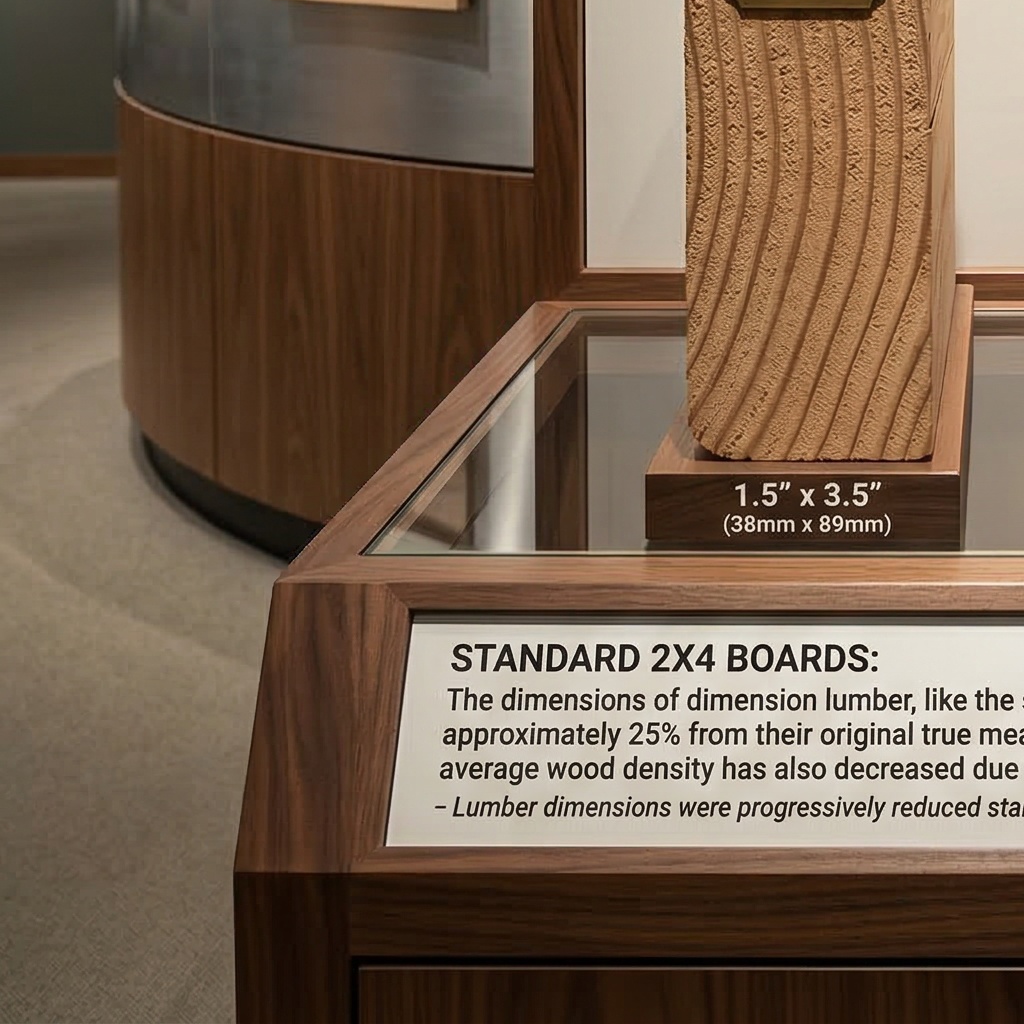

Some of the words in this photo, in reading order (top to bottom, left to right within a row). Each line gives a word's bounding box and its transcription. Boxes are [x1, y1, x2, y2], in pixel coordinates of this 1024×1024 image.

[800, 489, 815, 506] x
[724, 514, 795, 537] (38mm
[802, 520, 812, 532] x
[820, 514, 891, 536] 89mm)
[451, 644, 640, 672] STANDARD
[651, 644, 715, 672] 2X4
[728, 644, 878, 672] BOARDS:
[447, 687, 493, 711] The
[502, 687, 645, 711] dimensions
[654, 687, 680, 711] of
[687, 687, 816, 711] dimension
[826, 687, 916, 715] lumber,
[926, 687, 967, 711] like
[975, 687, 1014, 711] the
[443, 721, 621, 750] approximately
[629, 722, 680, 745] 25%
[689, 721, 747, 745] from
[756, 721, 813, 745] their
[821, 721, 913, 750] original
[922, 724, 971, 745] true
[440, 762, 539, 784] average
[547, 756, 614, 779] wood
[624, 756, 714, 784] density
[723, 756, 766, 779] has
[775, 756, 826, 779] also
[835, 756, 964, 780] decreased
[973, 756, 1018, 779] due
[453, 795, 538, 817] Lumber
[544, 796, 671, 817] dimensions
[680, 801, 731, 817] were
[737, 796, 886, 822] progressively
[892, 796, 981, 817] reduced
